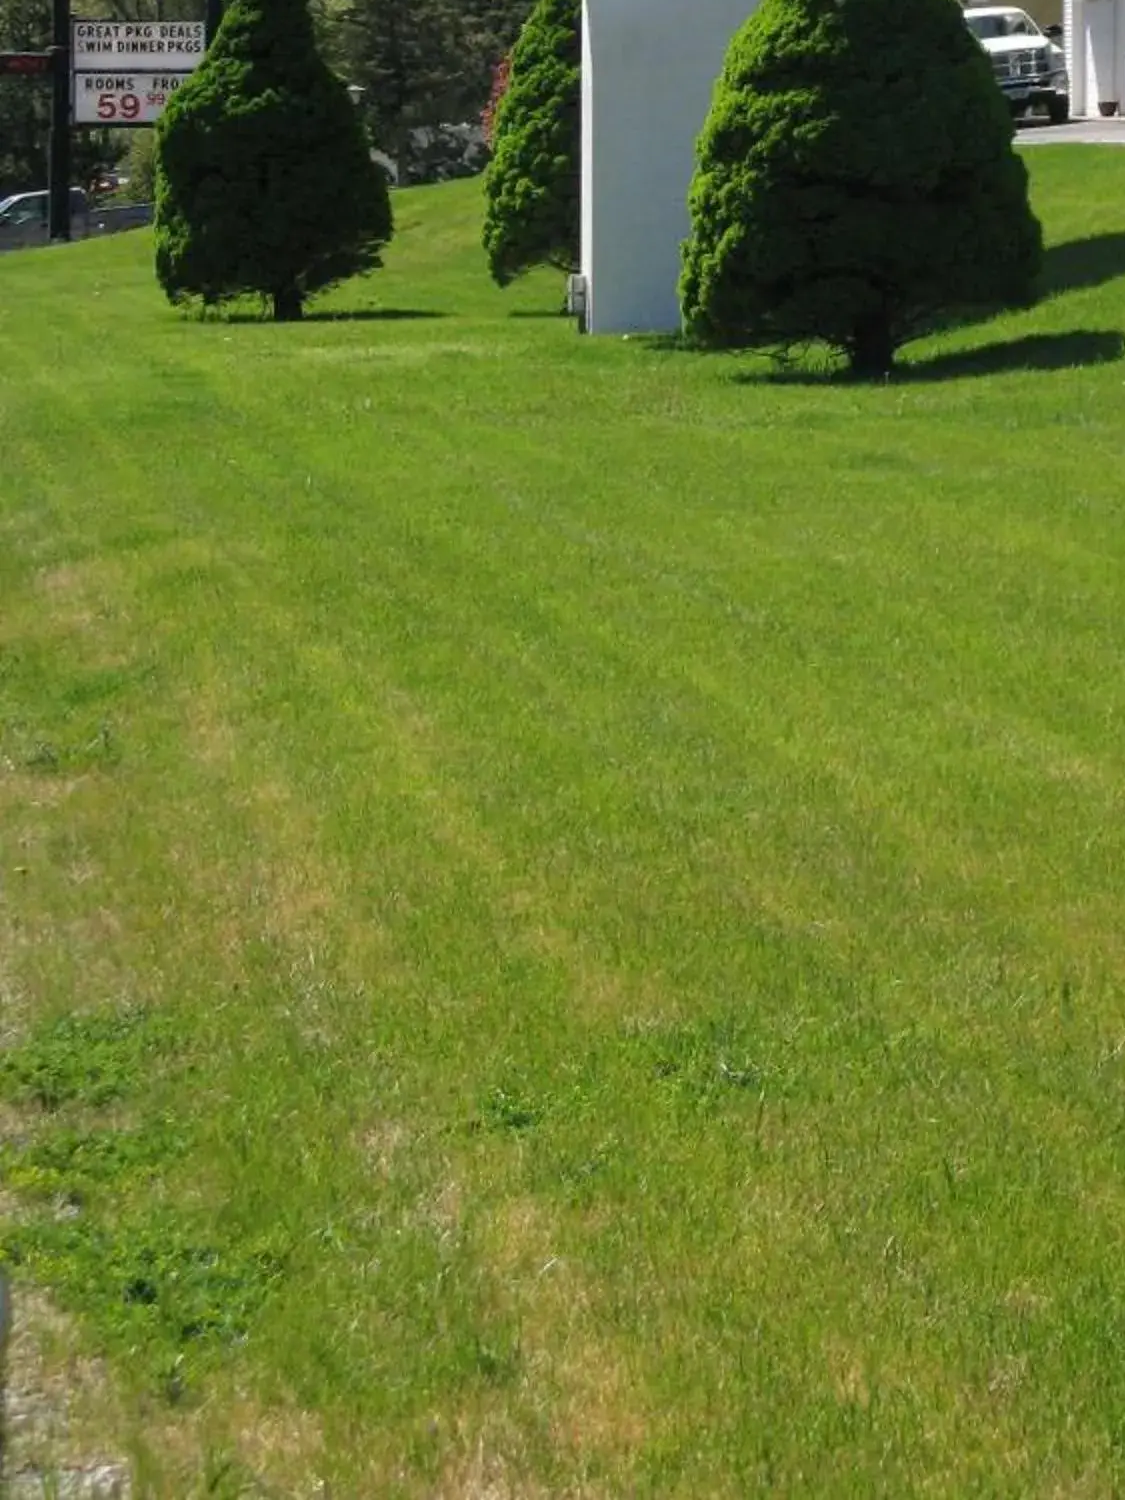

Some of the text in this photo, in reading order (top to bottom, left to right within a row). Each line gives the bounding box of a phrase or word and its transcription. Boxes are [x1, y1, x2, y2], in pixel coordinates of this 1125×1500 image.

[77, 25, 202, 38] GREAT PKG DEALS
[117, 40, 165, 53] DINNER
[168, 40, 202, 53] PKGS
[85, 77, 135, 90] ROOMS
[97, 93, 141, 119] 59
